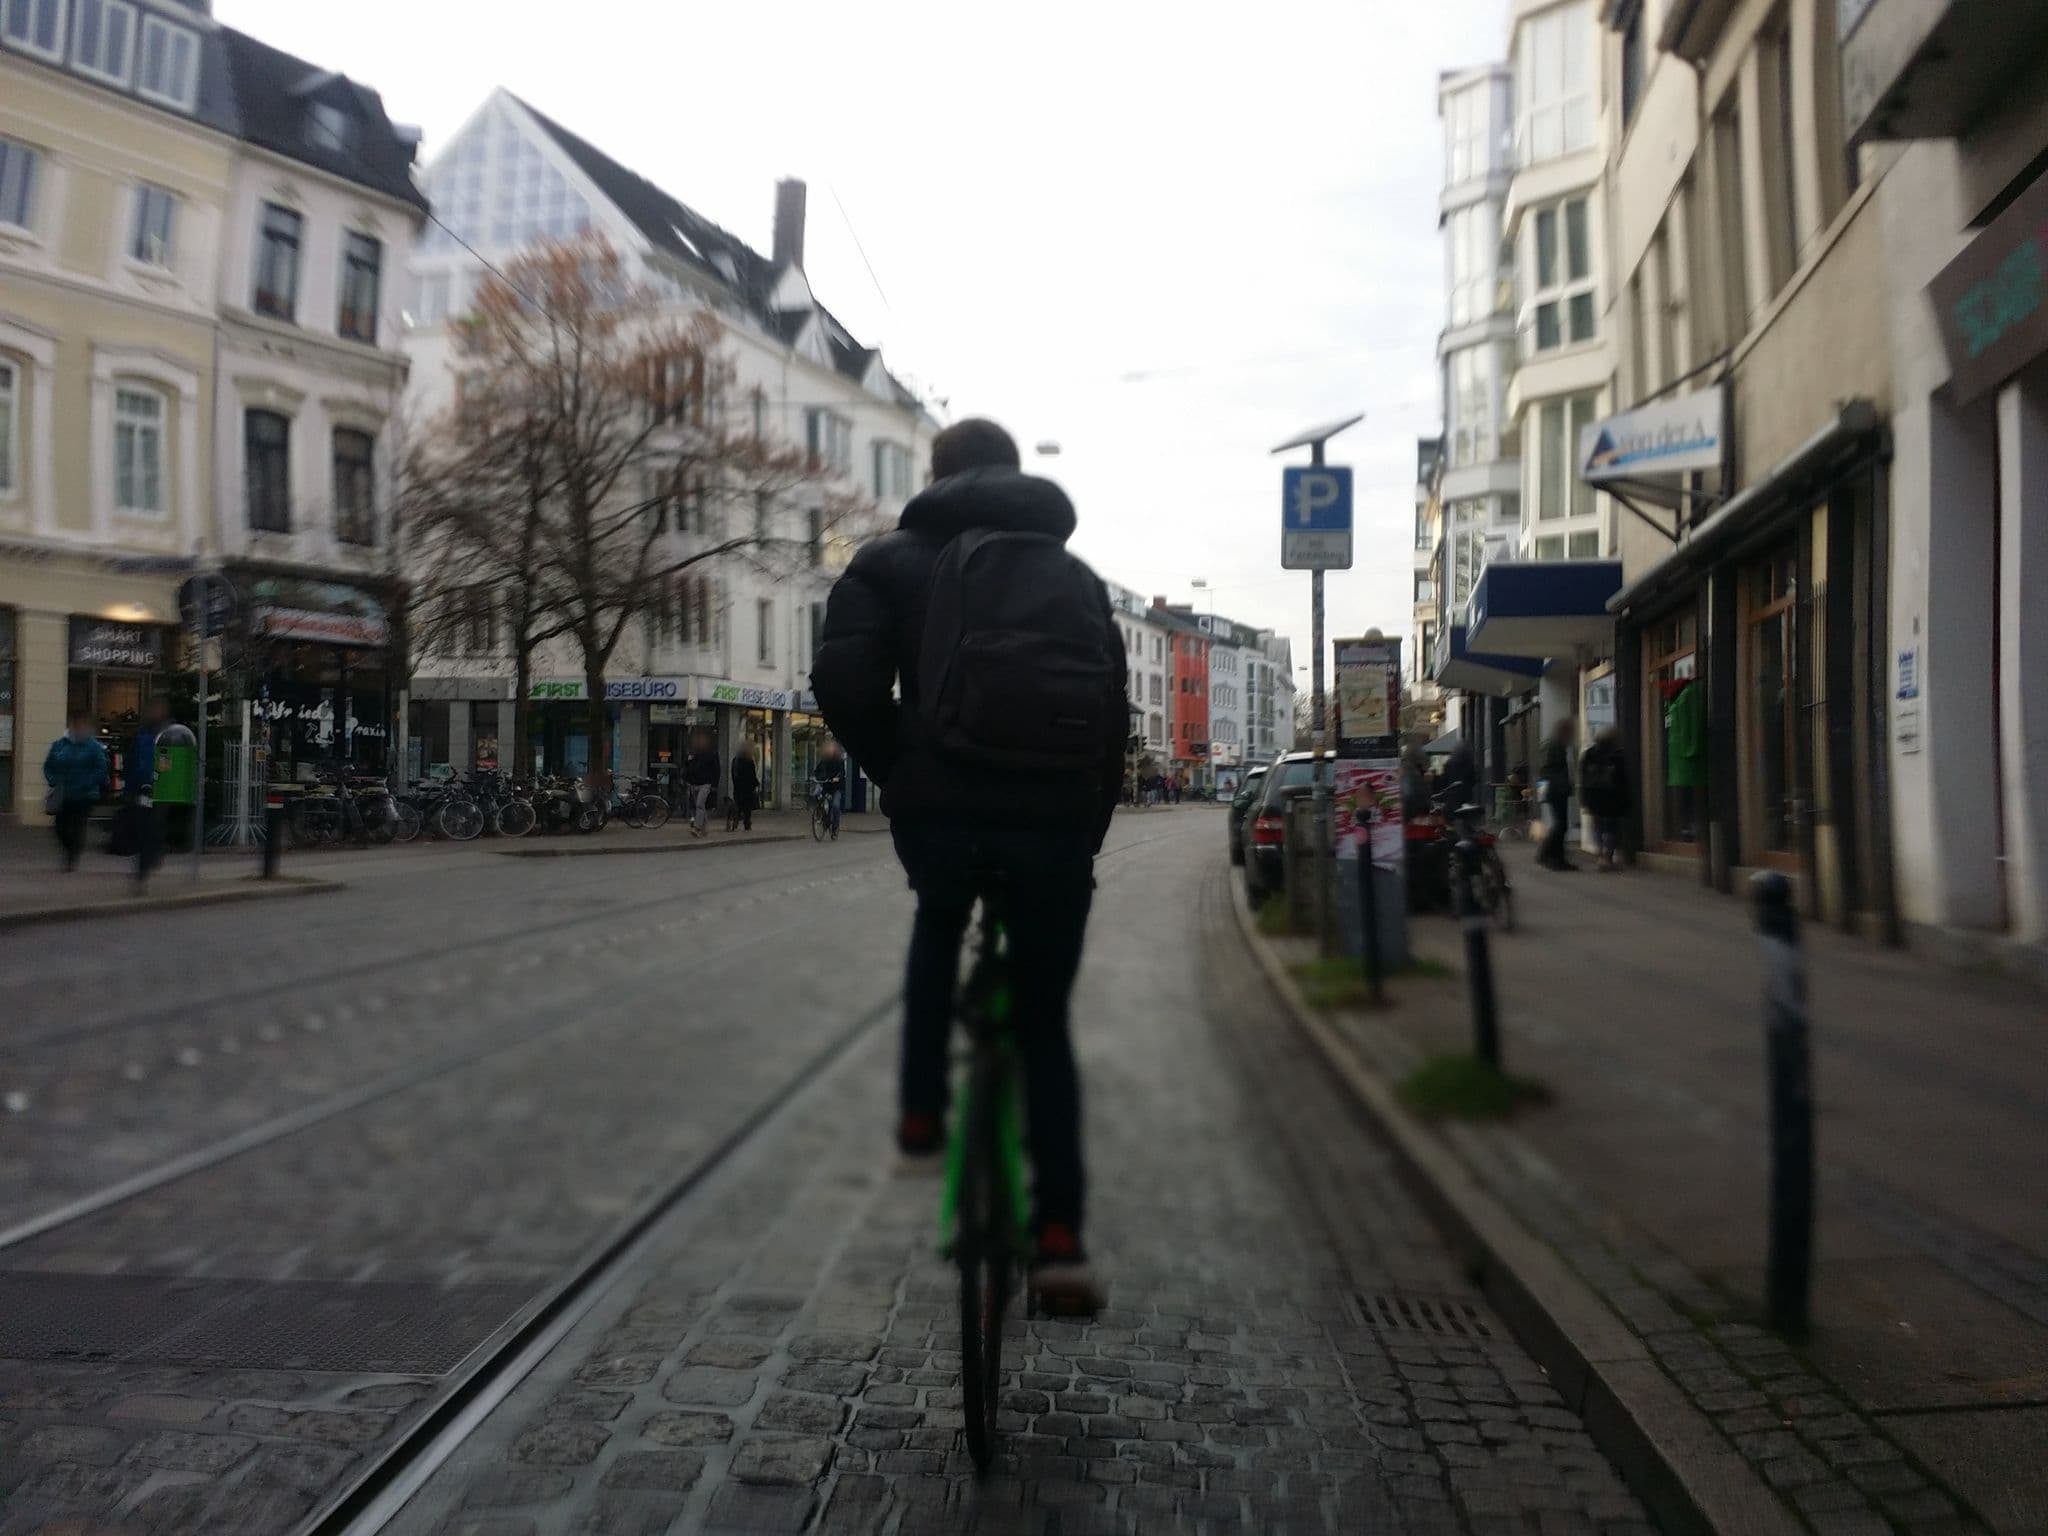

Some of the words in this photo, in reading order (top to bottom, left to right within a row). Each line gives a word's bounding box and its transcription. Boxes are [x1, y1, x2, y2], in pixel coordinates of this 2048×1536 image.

[1300, 473, 1339, 523] P
[80, 646, 155, 665] SHOPPING
[534, 681, 583, 698] FIRST
[588, 679, 677, 698] ISEBÜRO
